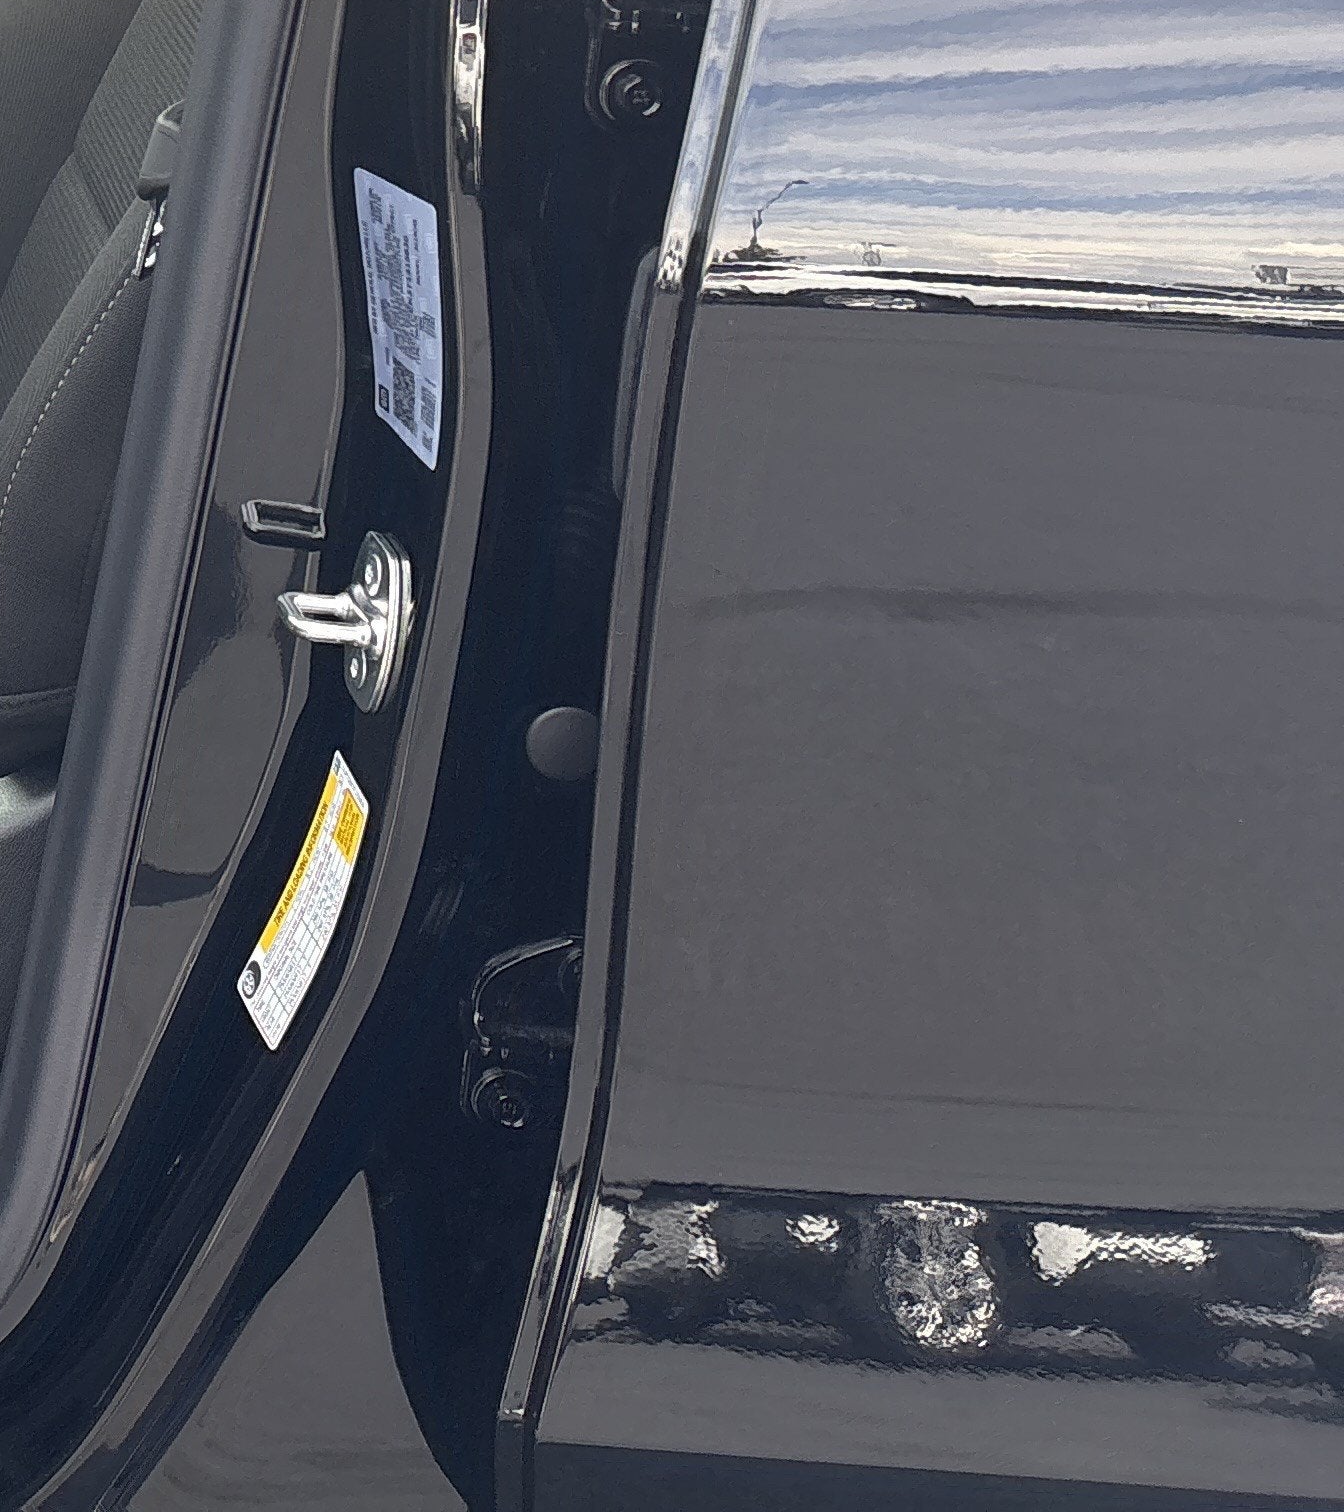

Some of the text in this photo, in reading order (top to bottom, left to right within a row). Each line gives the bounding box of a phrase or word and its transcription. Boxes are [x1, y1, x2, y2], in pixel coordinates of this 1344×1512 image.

[283, 889, 293, 910] AND
[290, 854, 308, 892] LOADING
[306, 801, 328, 856] INFORMATION
